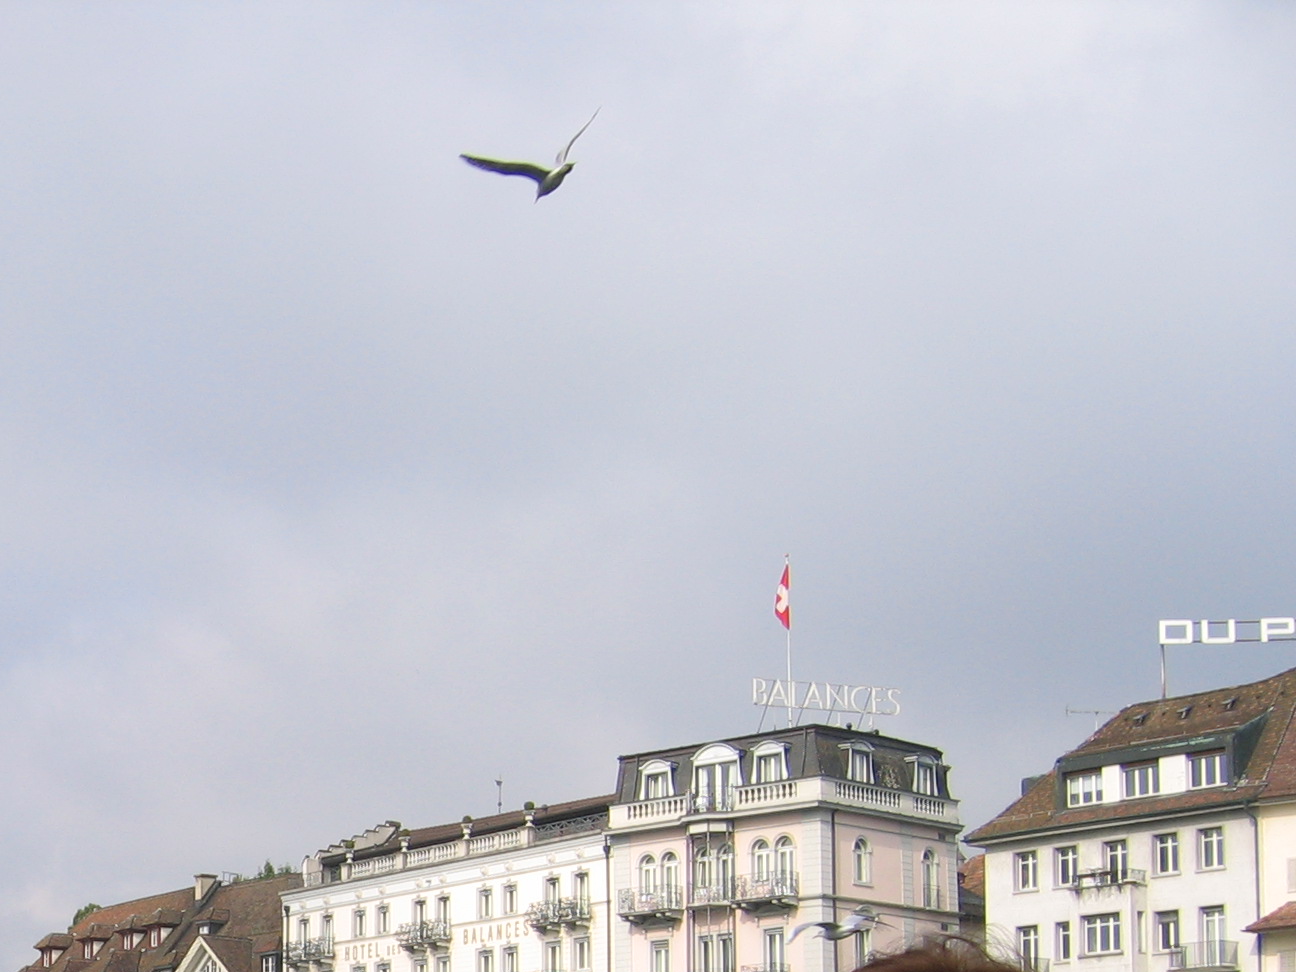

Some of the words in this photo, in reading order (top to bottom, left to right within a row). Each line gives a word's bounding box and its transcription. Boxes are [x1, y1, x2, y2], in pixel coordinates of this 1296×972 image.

[752, 677, 902, 716] BALANCES
[344, 942, 381, 962] HOTEL
[463, 919, 530, 945] BALANCES
